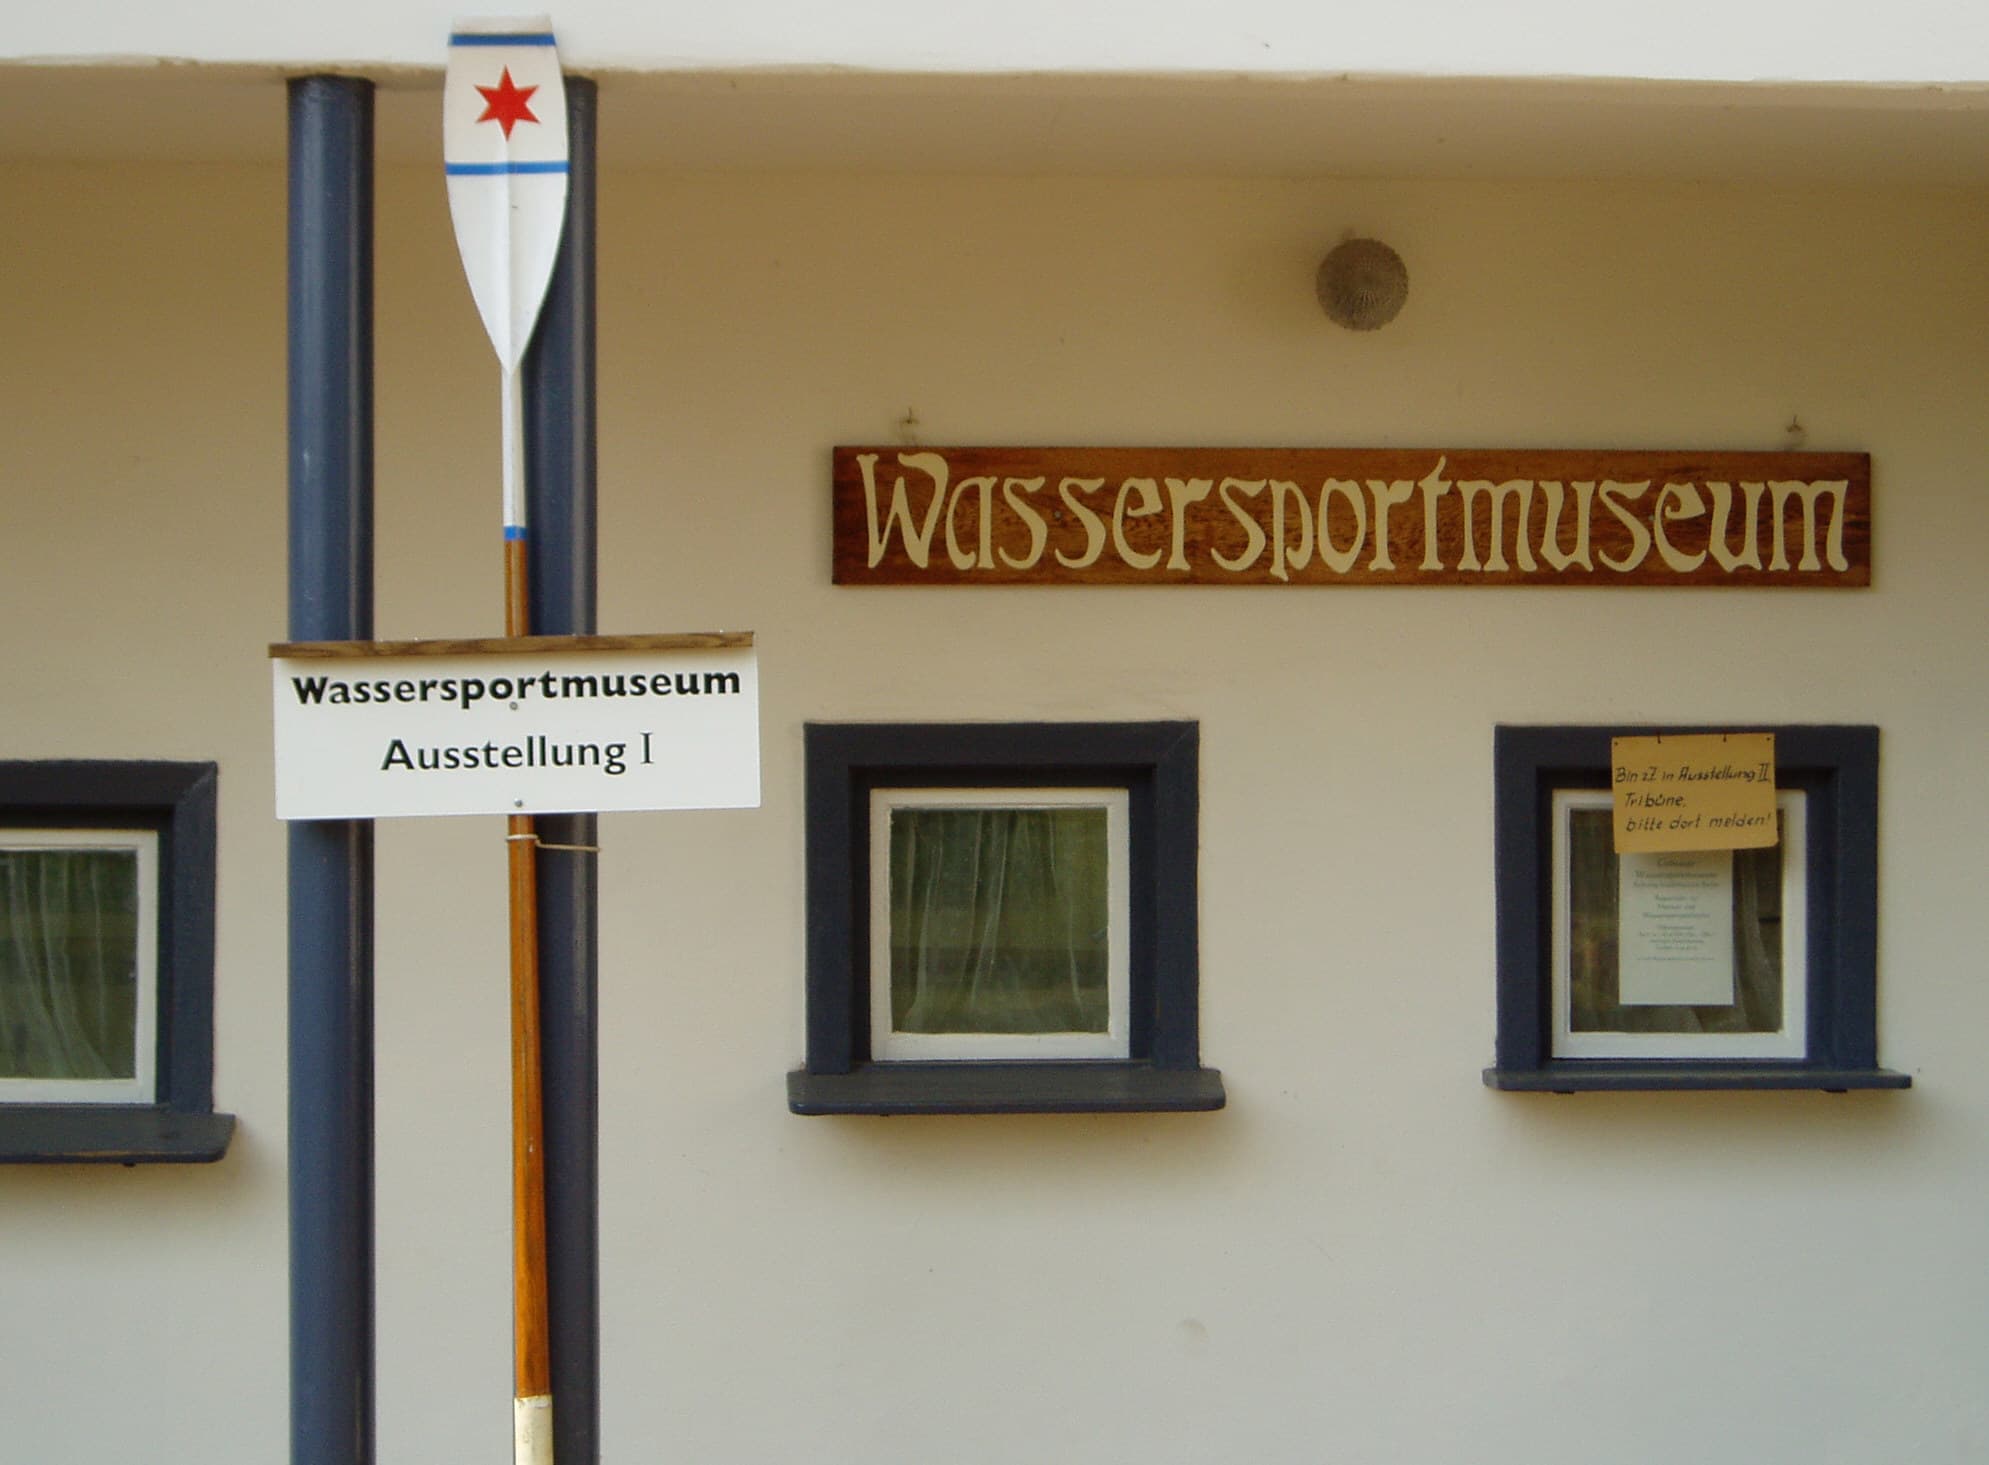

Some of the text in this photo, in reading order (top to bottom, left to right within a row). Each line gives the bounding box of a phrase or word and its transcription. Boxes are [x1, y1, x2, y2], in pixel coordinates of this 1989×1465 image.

[856, 452, 1850, 580] Wassersportmuseum
[291, 670, 740, 709] Wassersportmuseum
[381, 731, 655, 775] Ausstellung I
[1615, 767, 1638, 783] Bin
[1662, 769, 1675, 781] in
[1678, 764, 1755, 782] Ausstellung
[1757, 762, 1770, 782] II
[1626, 812, 1771, 832] bitte dort melden!
